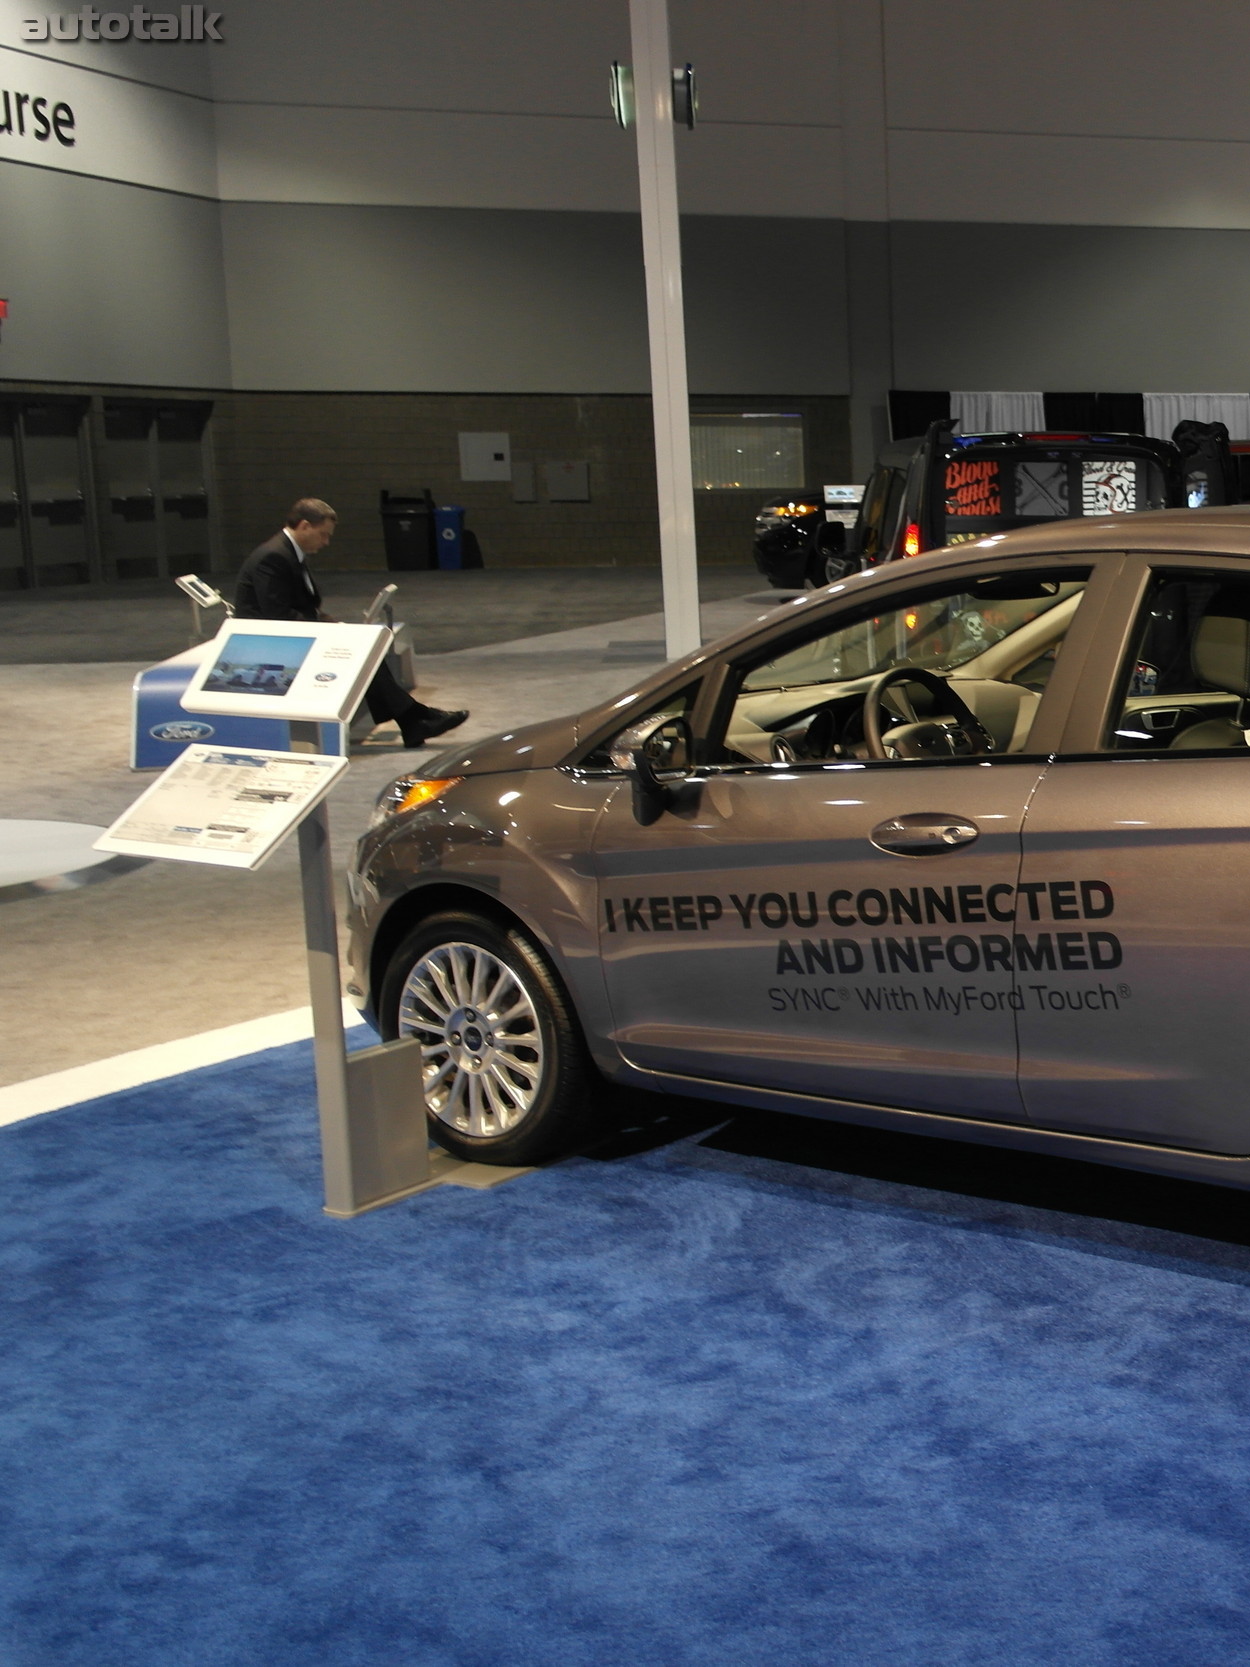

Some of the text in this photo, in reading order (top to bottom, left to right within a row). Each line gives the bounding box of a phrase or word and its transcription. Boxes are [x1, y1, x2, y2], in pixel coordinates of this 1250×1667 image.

[161, 723, 200, 740] Ford
[604, 880, 1114, 933] I KEEP YOU CONNECTED
[776, 931, 1123, 975] AND INFORMED
[855, 985, 918, 1011] With
[924, 984, 1025, 1016] MyFord
